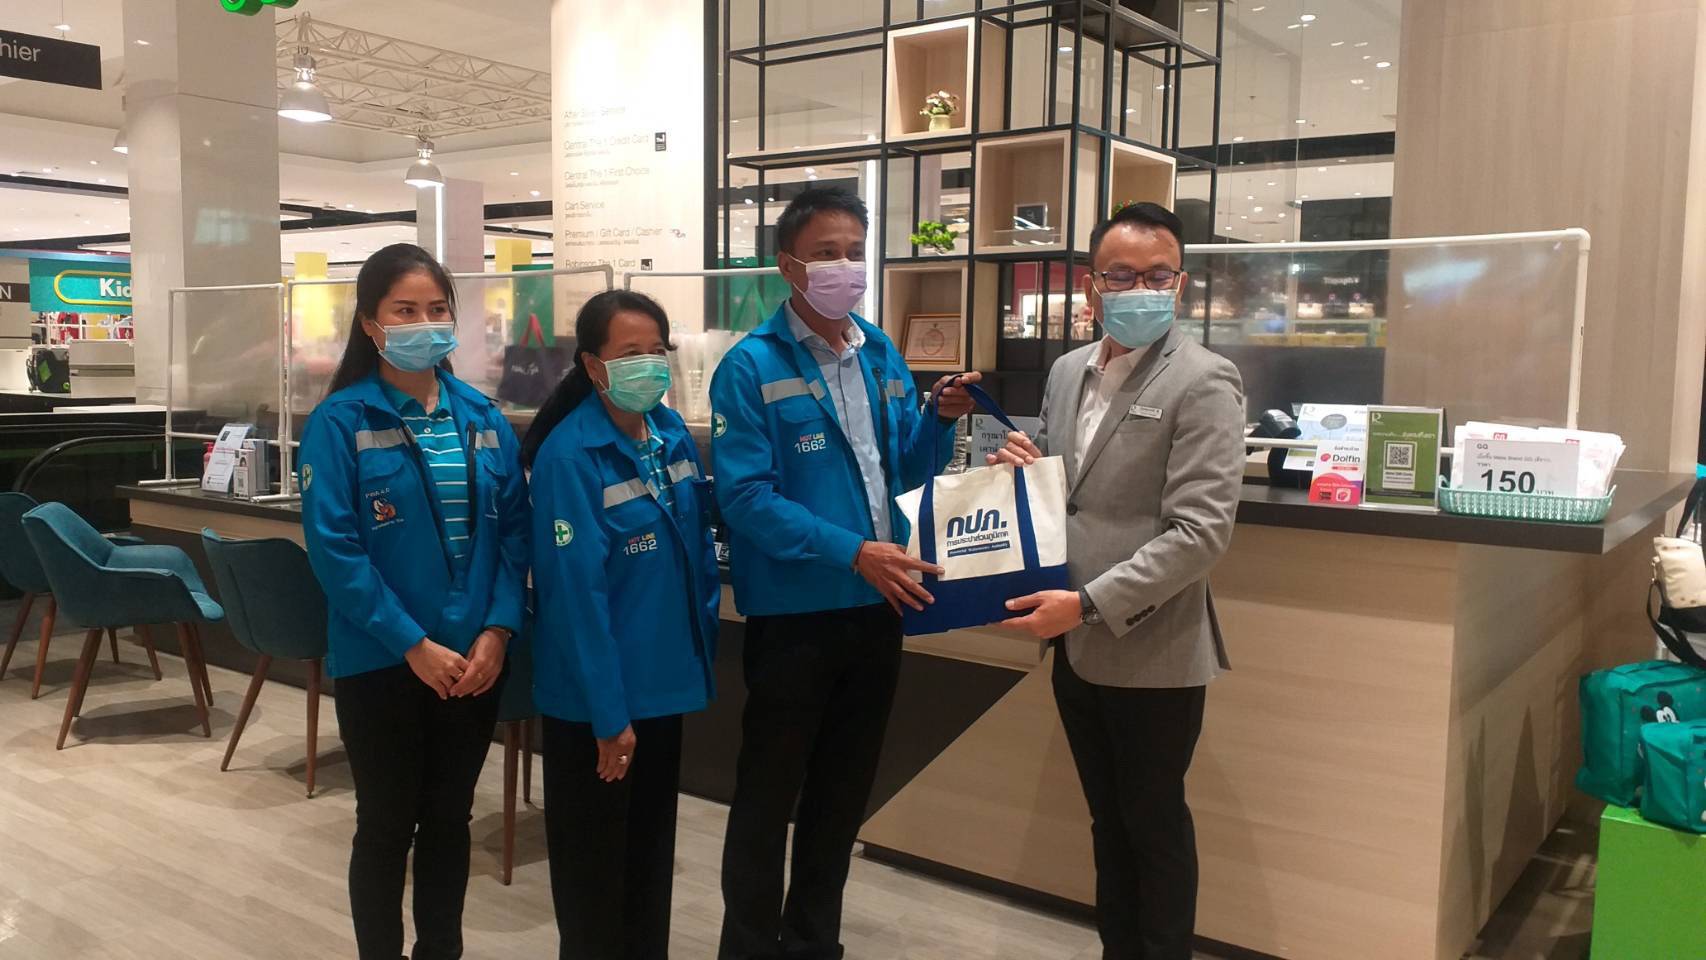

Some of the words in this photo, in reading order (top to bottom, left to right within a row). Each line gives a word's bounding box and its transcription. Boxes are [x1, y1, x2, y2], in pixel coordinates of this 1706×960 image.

[564, 201, 579, 210] Cart
[580, 200, 605, 210] Service
[565, 229, 594, 239] Premium
[613, 227, 631, 237] Card
[618, 258, 636, 267] Card
[794, 439, 826, 453] 1662
[1332, 454, 1360, 463] Dolfin
[1481, 469, 1536, 494] 150
[946, 508, 1007, 538] กปภ.
[623, 539, 658, 555] 1662
